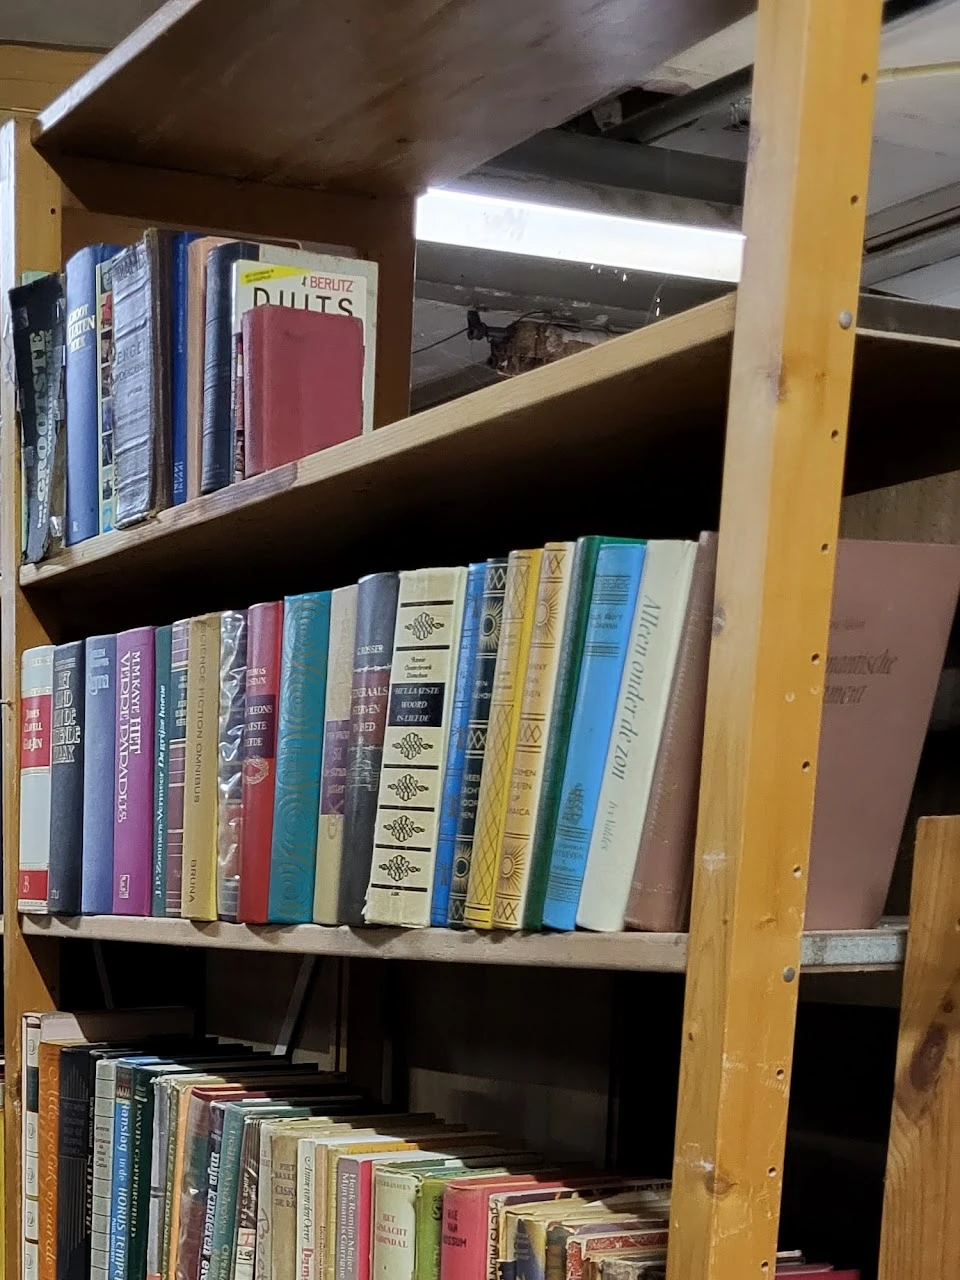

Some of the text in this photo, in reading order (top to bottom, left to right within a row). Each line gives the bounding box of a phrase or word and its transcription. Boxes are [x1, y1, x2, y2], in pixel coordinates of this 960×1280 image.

[310, 275, 353, 293] BERLITZ
[29, 329, 49, 502] GROOTSTE
[401, 700, 428, 709] WOORD
[610, 594, 662, 781] Alleen onder de zon
[129, 716, 143, 754] HET
[192, 743, 203, 804] OMNIBUS
[187, 859, 198, 904] BRUNA
[115, 1186, 128, 1231] HORUS
[347, 1173, 356, 1200] Henk
